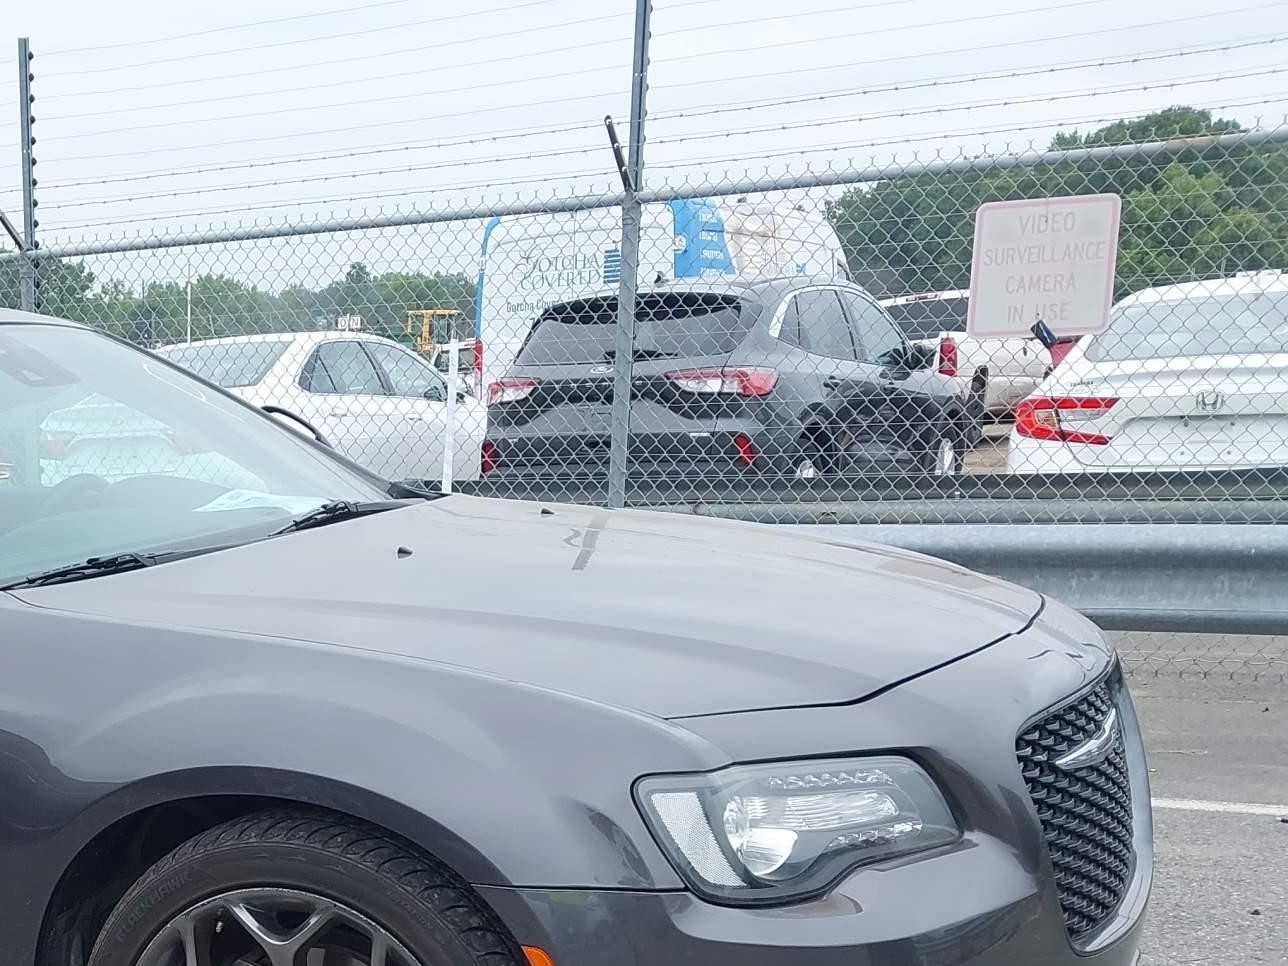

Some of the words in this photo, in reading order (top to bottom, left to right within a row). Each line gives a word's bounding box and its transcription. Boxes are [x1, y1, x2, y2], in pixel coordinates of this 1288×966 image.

[1018, 211, 1076, 235] VIDEO
[512, 243, 601, 277] GOTCHA
[983, 241, 1106, 267] SURVEILLANCE
[520, 269, 601, 290] COVERED
[1005, 272, 1077, 295] CAMERA
[1007, 304, 1024, 323] IN
[1035, 302, 1072, 322] USE
